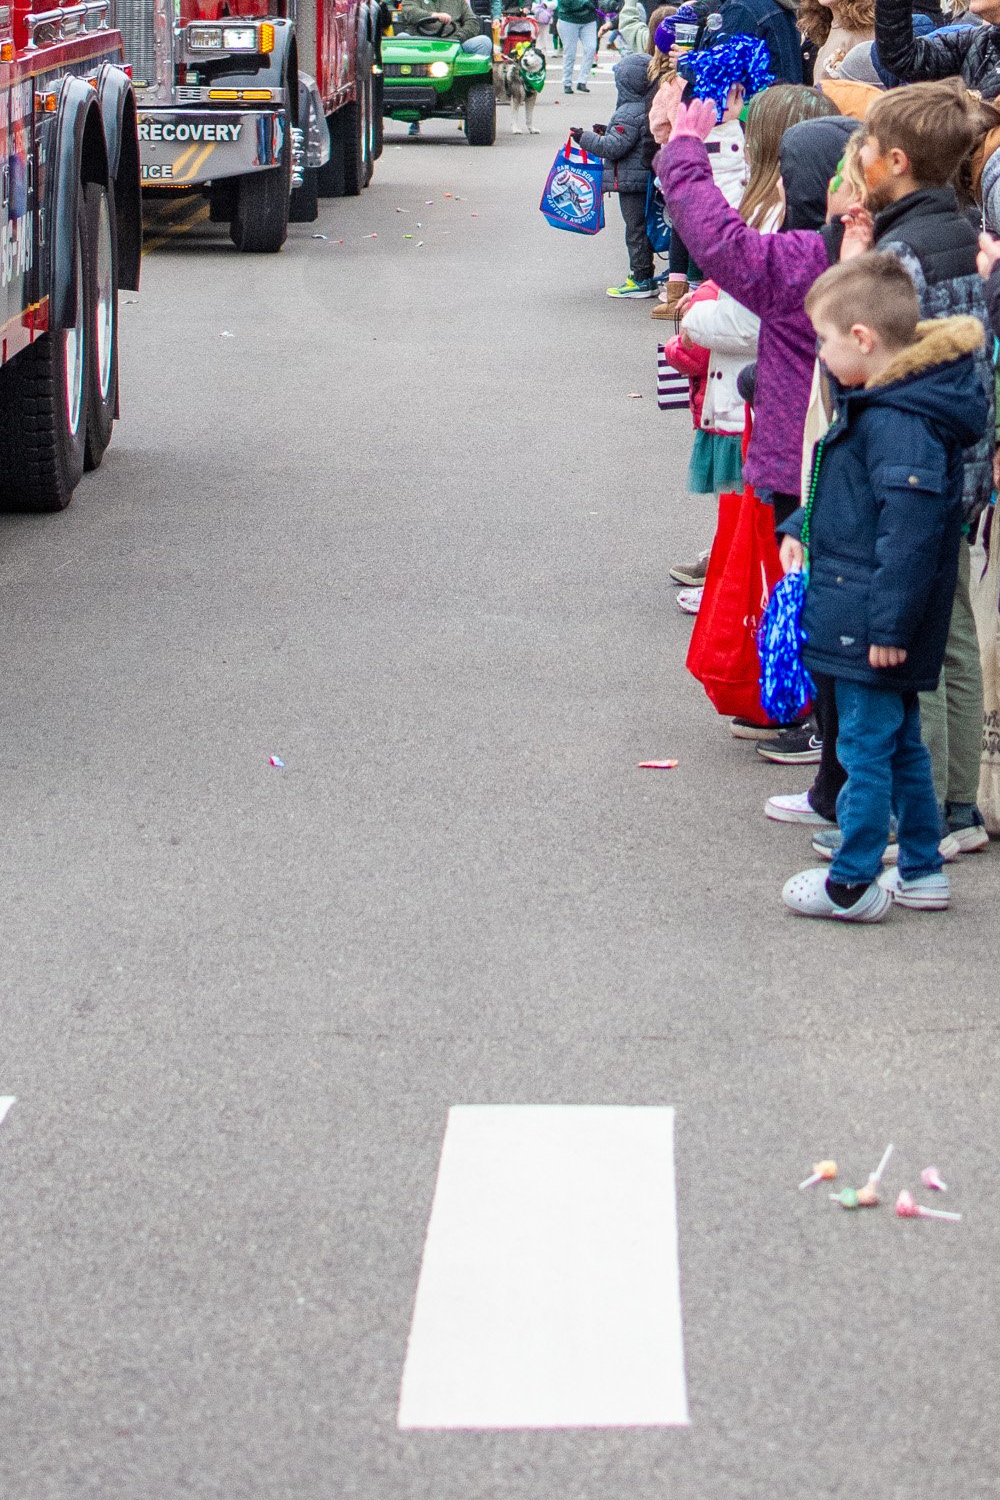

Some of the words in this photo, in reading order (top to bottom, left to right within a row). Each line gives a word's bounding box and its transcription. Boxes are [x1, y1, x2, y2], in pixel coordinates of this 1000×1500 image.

[137, 124, 242, 141] RECOVERY
[140, 165, 173, 178] ICE
[556, 164, 570, 173] SAM
[571, 167, 595, 182] WILSON
[546, 194, 569, 220] CAPTAIN
[570, 210, 596, 224] AMERICA
